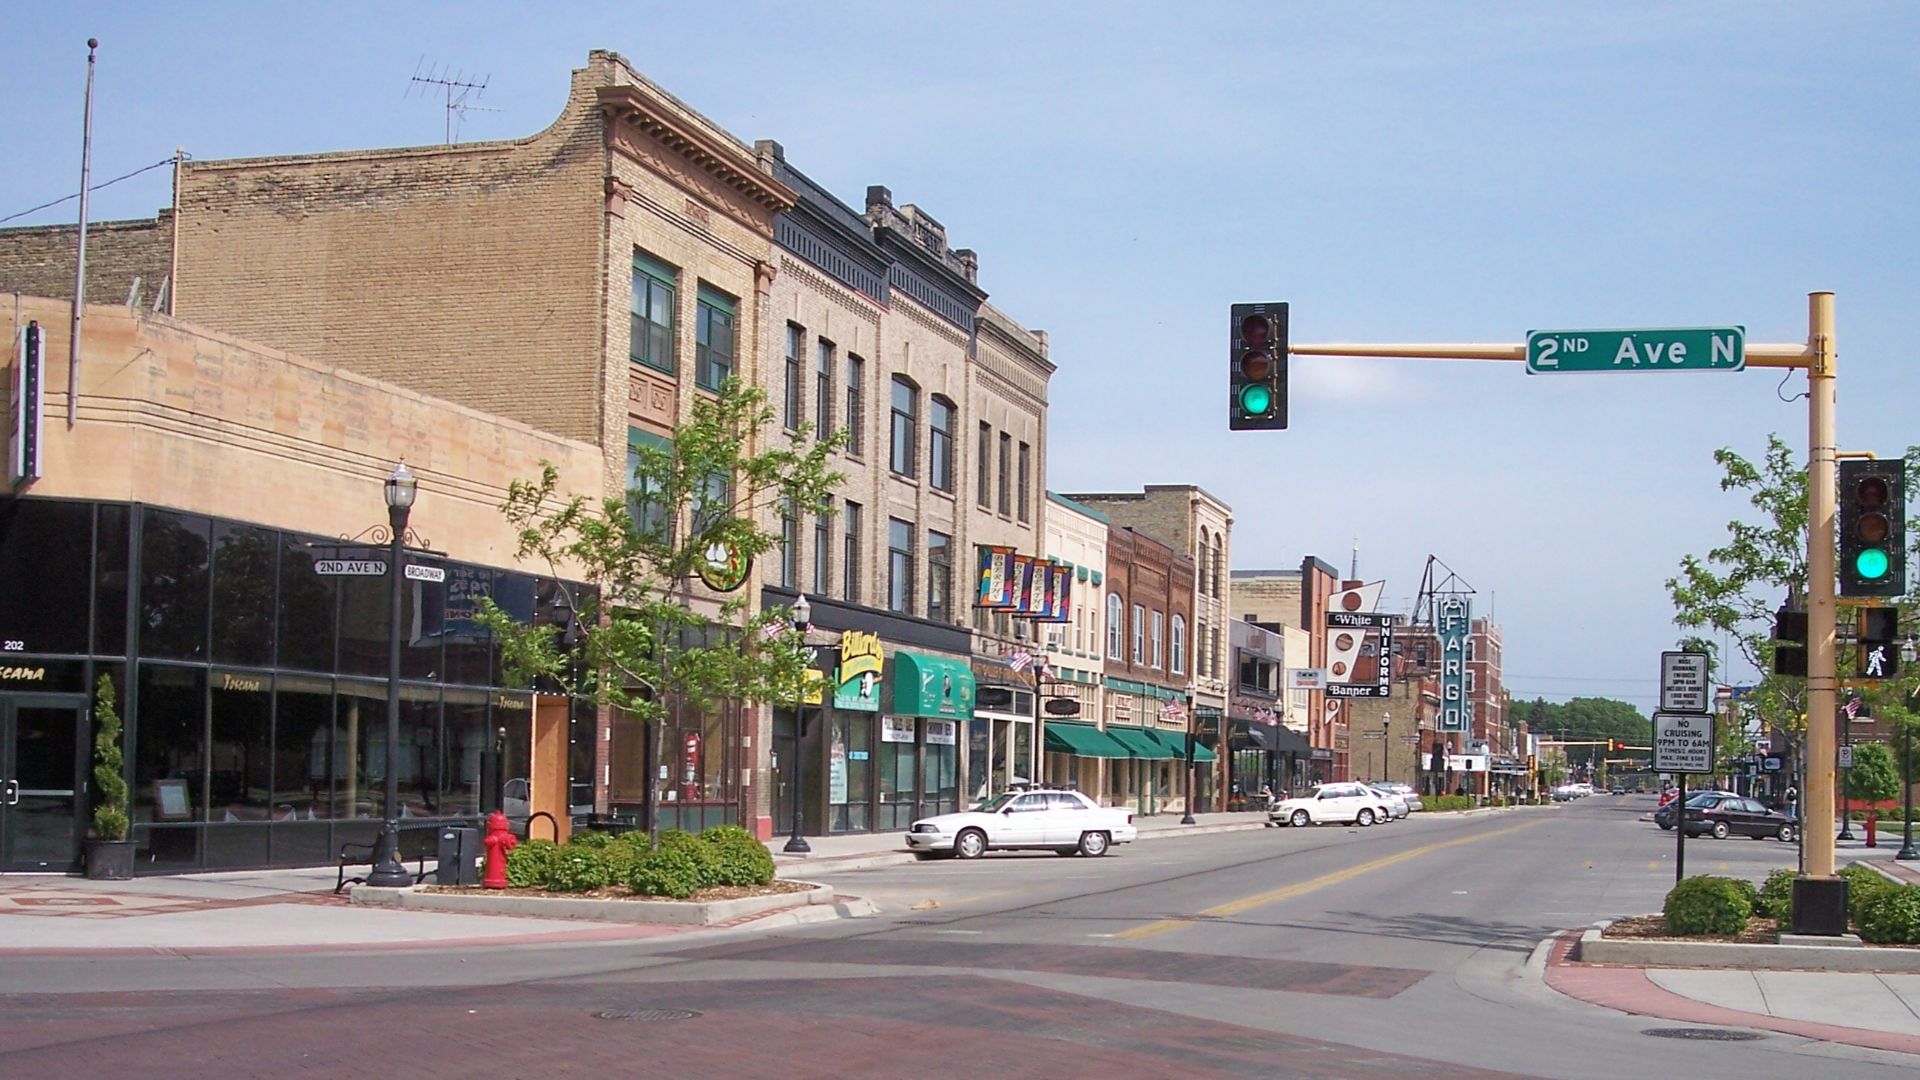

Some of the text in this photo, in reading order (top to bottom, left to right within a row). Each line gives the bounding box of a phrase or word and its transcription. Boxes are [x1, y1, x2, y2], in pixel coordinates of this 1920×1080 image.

[1536, 335, 1735, 366] 2ND Ave N
[320, 562, 382, 572] 2ND AVE N
[407, 566, 442, 579] BROADWAY
[1335, 614, 1371, 626] White
[4, 640, 24, 651] 202
[1380, 617, 1390, 696] UNIFORMS
[1445, 614, 1460, 725] FARGO
[1329, 685, 1371, 697] Banner
[1678, 720, 1690, 728] NO
[1664, 729, 1703, 738] CRUISING
[1657, 738, 1710, 748] 9PM TO 6AM
